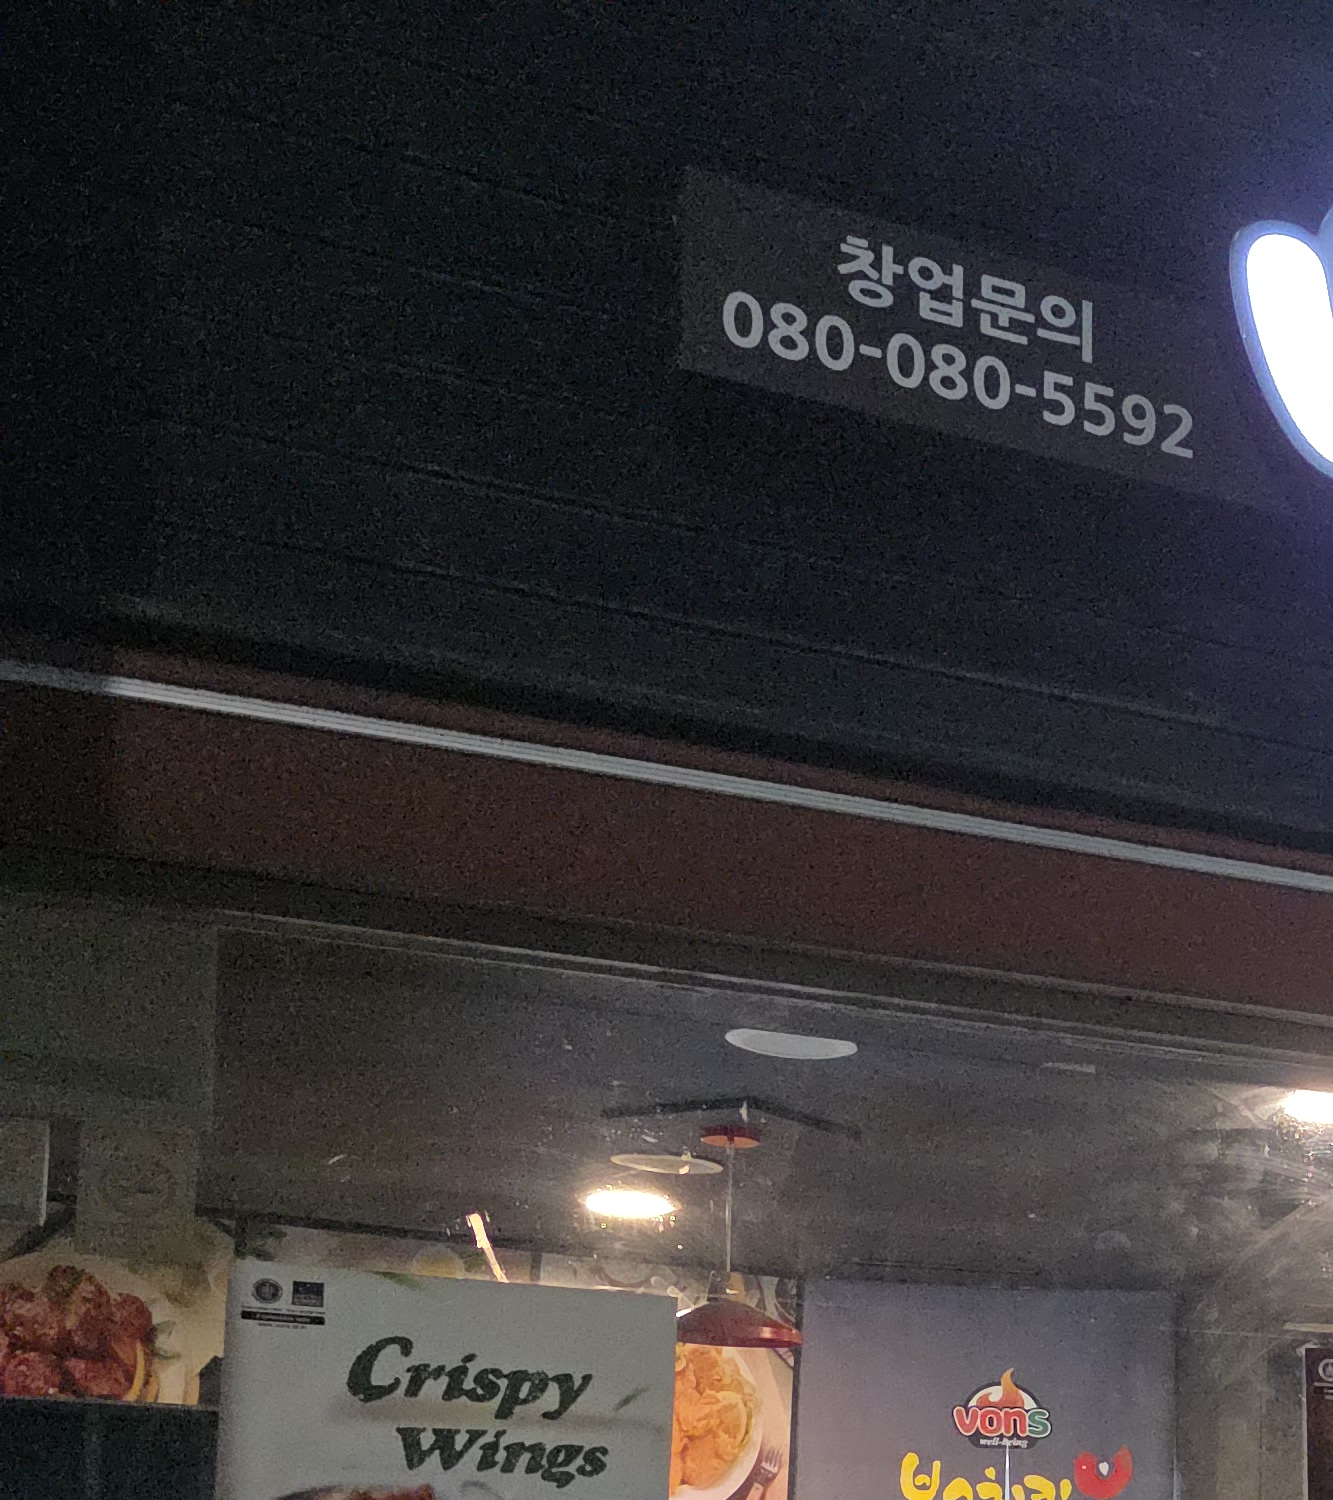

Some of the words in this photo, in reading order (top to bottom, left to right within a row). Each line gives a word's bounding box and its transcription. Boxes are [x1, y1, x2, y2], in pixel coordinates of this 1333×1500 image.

[836, 235, 1094, 363] 창업문의
[721, 290, 1194, 460] 080-080-5592
[345, 1335, 593, 1421] Crispy
[394, 1426, 610, 1488] Wings
[953, 1406, 1052, 1439] vons
